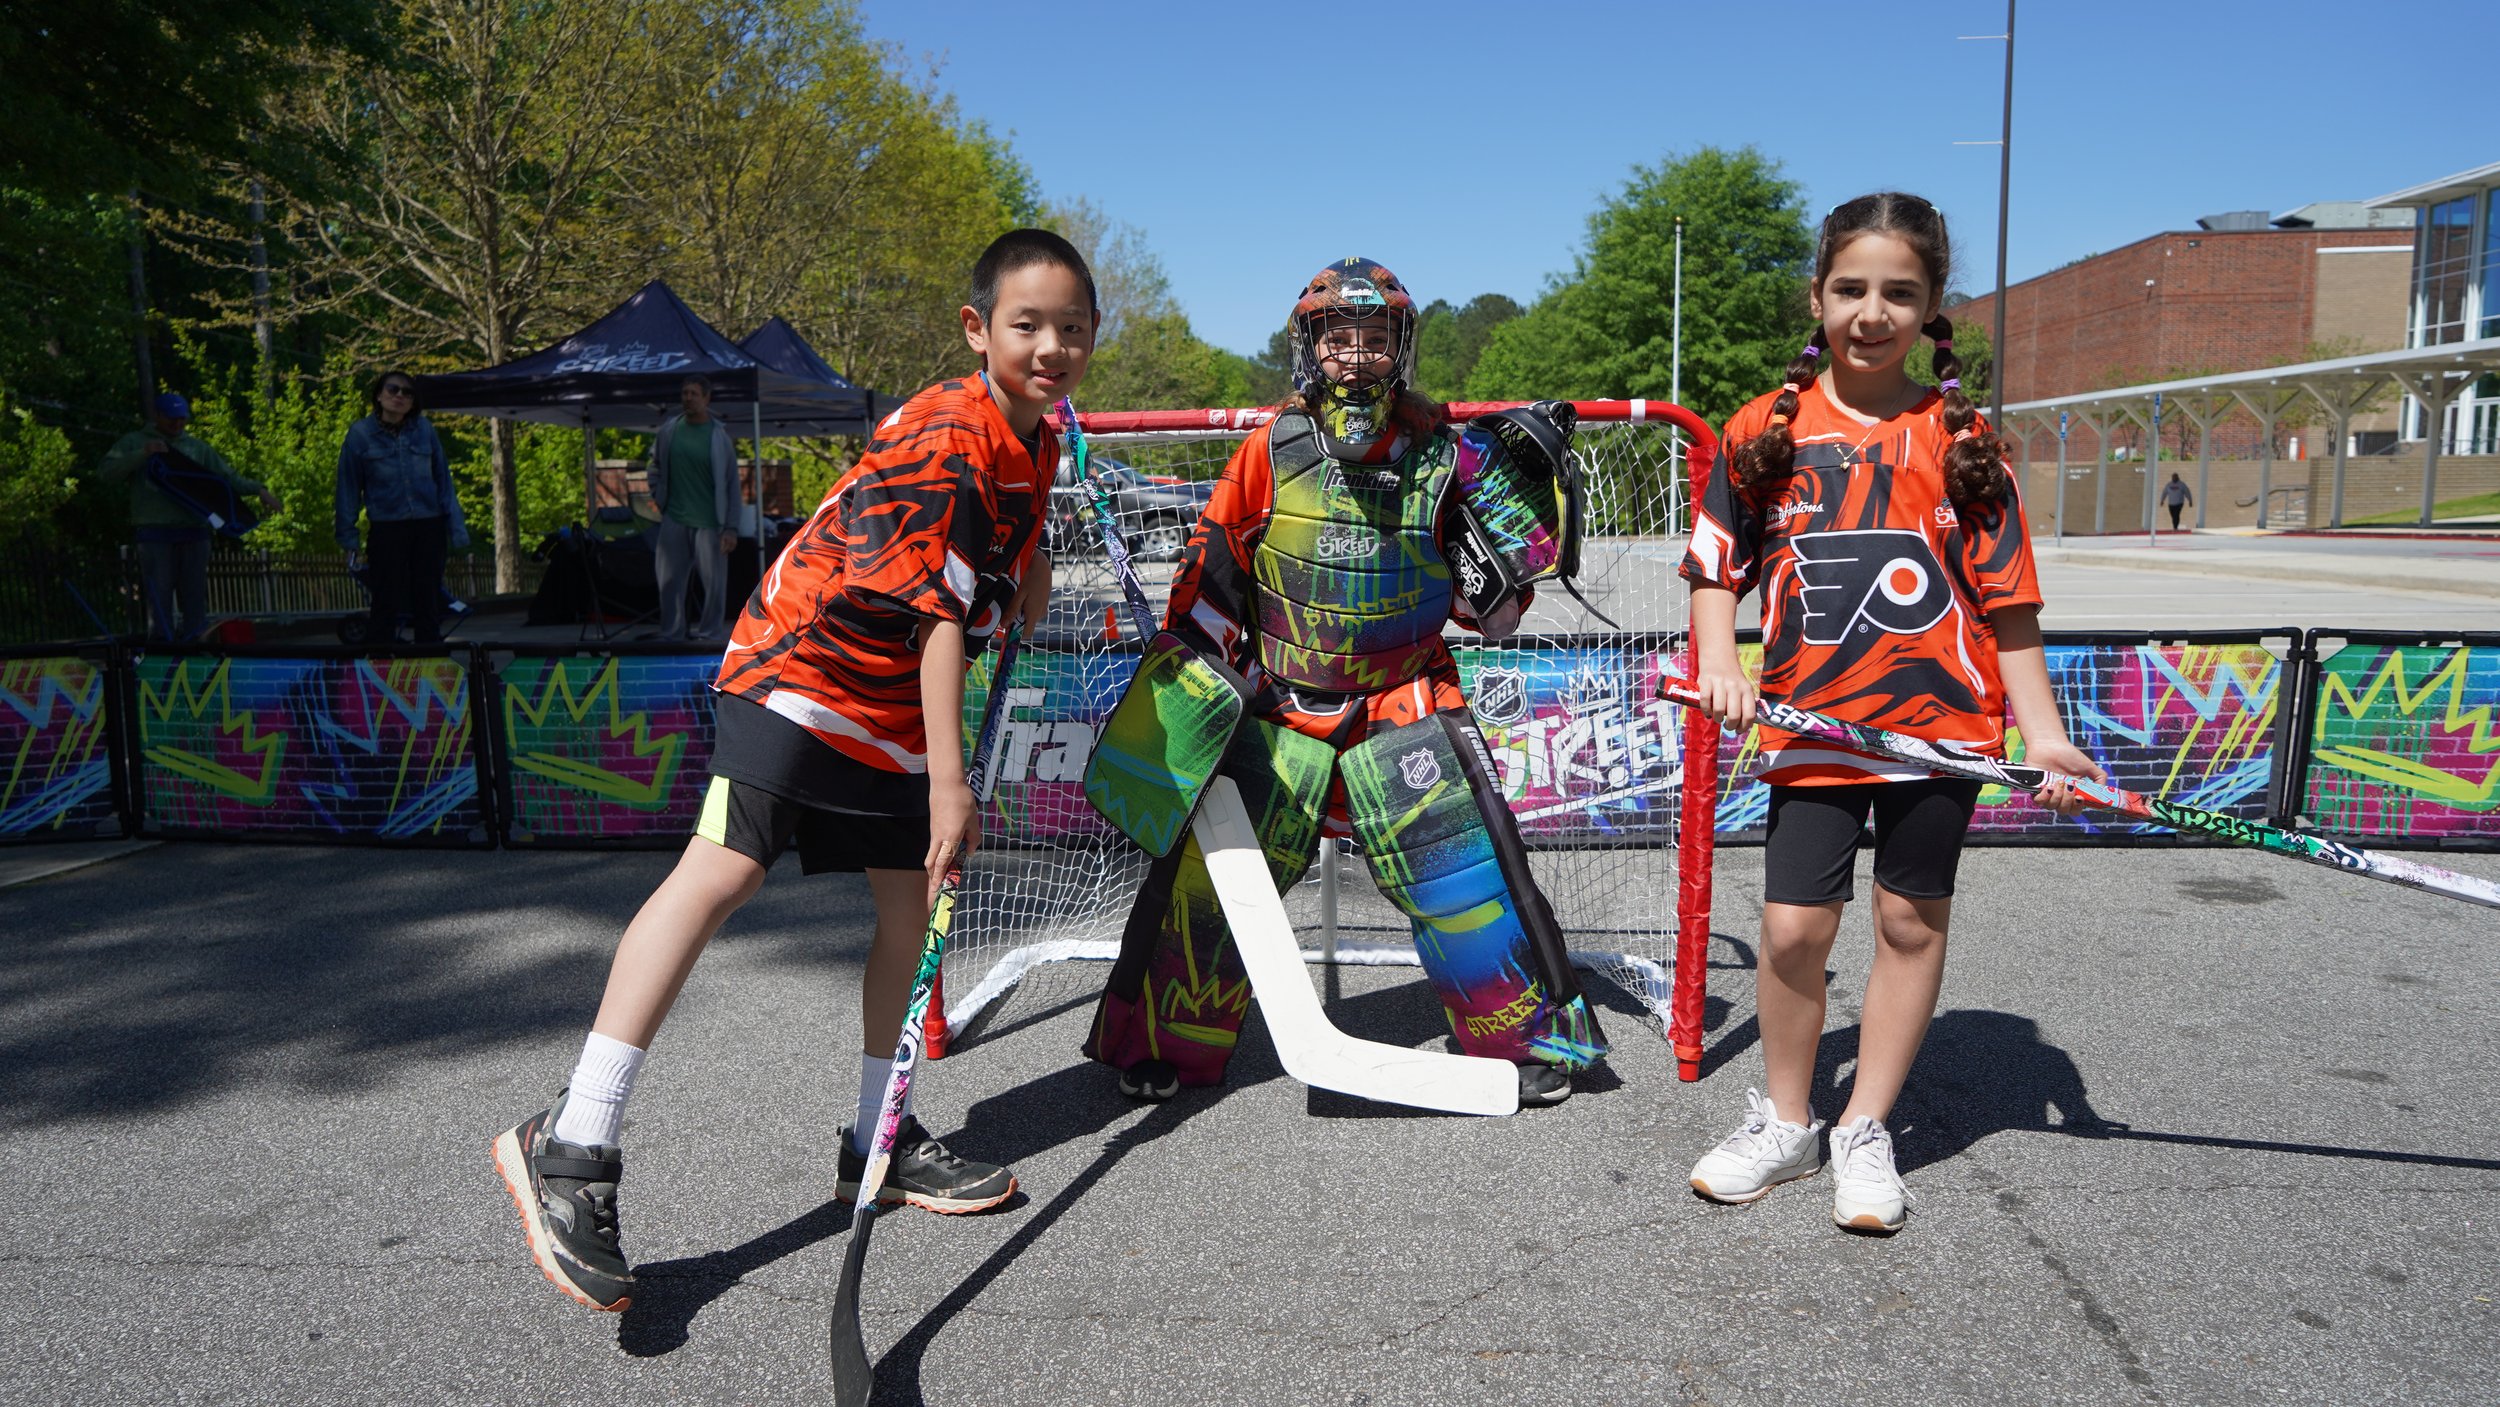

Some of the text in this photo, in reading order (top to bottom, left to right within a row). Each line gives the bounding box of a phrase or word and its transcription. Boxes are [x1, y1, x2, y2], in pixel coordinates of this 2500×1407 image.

[1317, 536, 1379, 561] STREET
[1303, 588, 1424, 628] STREET
[1485, 682, 1519, 713] NHL
[1465, 978, 1543, 1038] STREET
